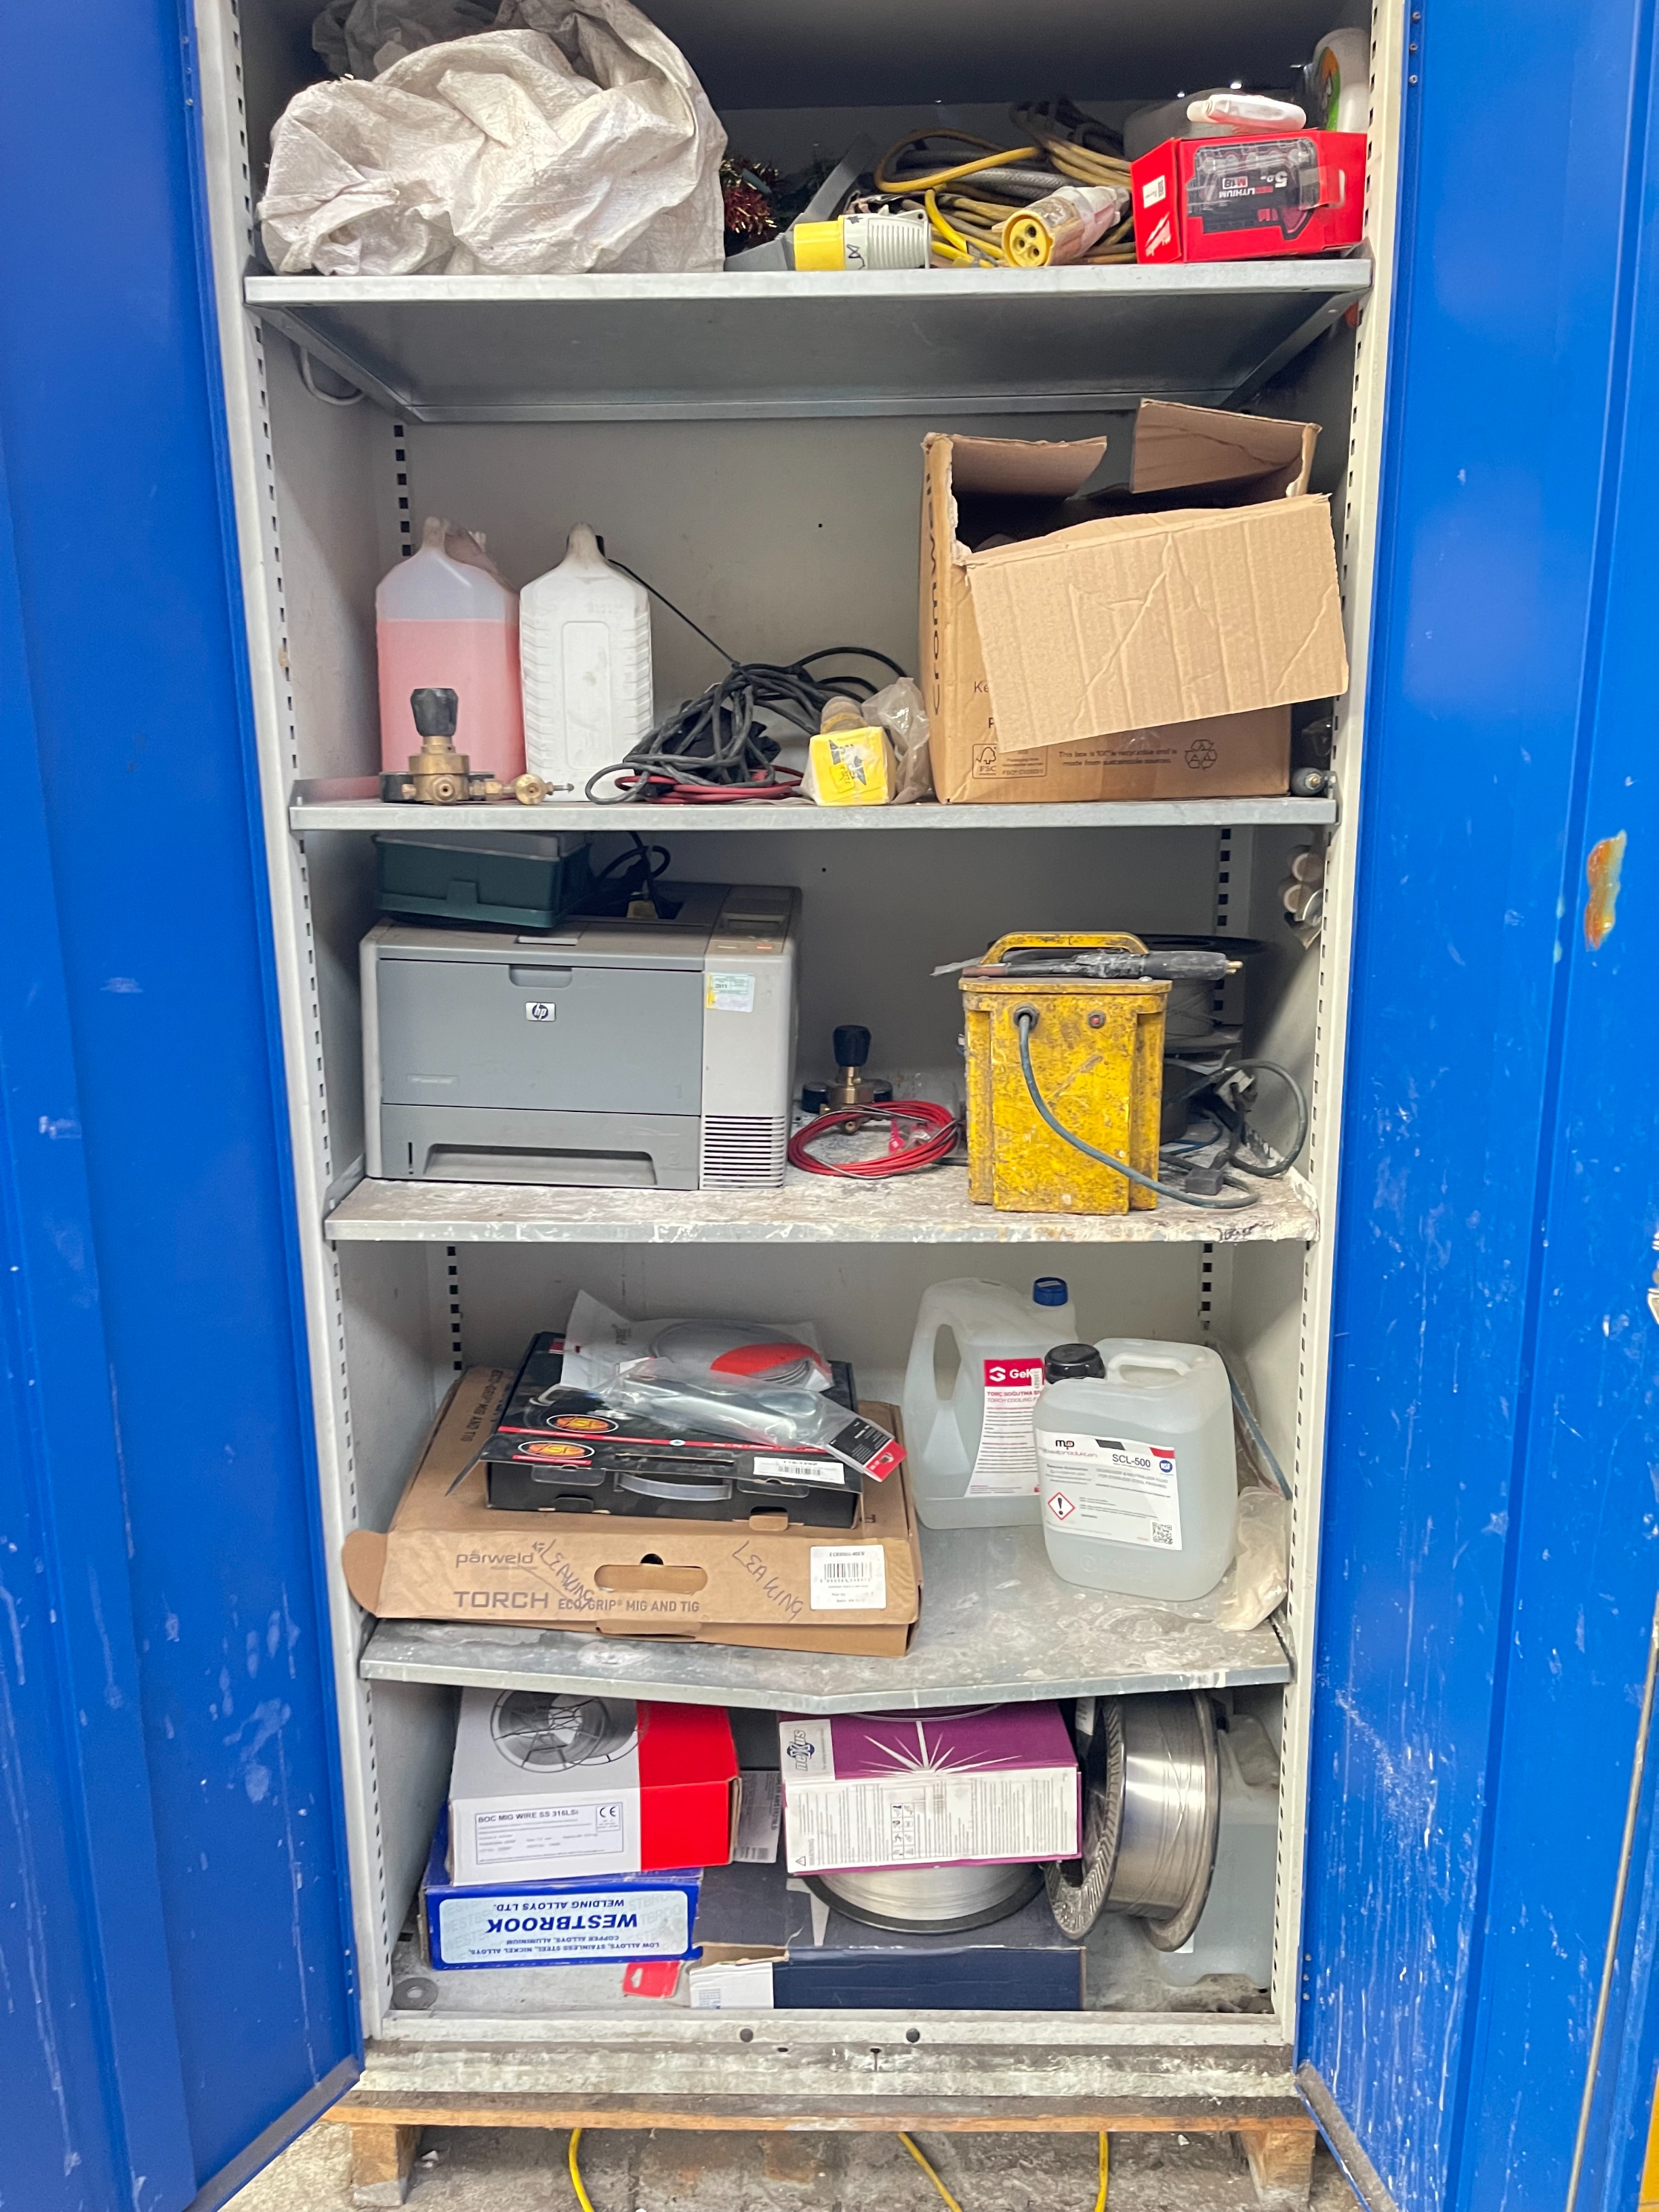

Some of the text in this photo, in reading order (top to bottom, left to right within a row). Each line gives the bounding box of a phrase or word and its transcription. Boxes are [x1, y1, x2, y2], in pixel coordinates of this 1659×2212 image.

[1223, 177, 1248, 189] M18
[533, 1002, 548, 1020] hp
[1112, 1454, 1151, 1468] SCL-500
[732, 1540, 804, 1622] LEAKING
[453, 1591, 549, 1609] TORCH
[626, 1599, 648, 1612] MIG
[651, 1600, 677, 1612] AND
[680, 1600, 699, 1612] TIG
[478, 1815, 496, 1823] BOC
[498, 1814, 514, 1822] MIG
[516, 1811, 537, 1820] WIRE
[493, 1899, 624, 1912] WELDING ALLOYS LTD.
[485, 1913, 638, 1933] WESTBROOK
